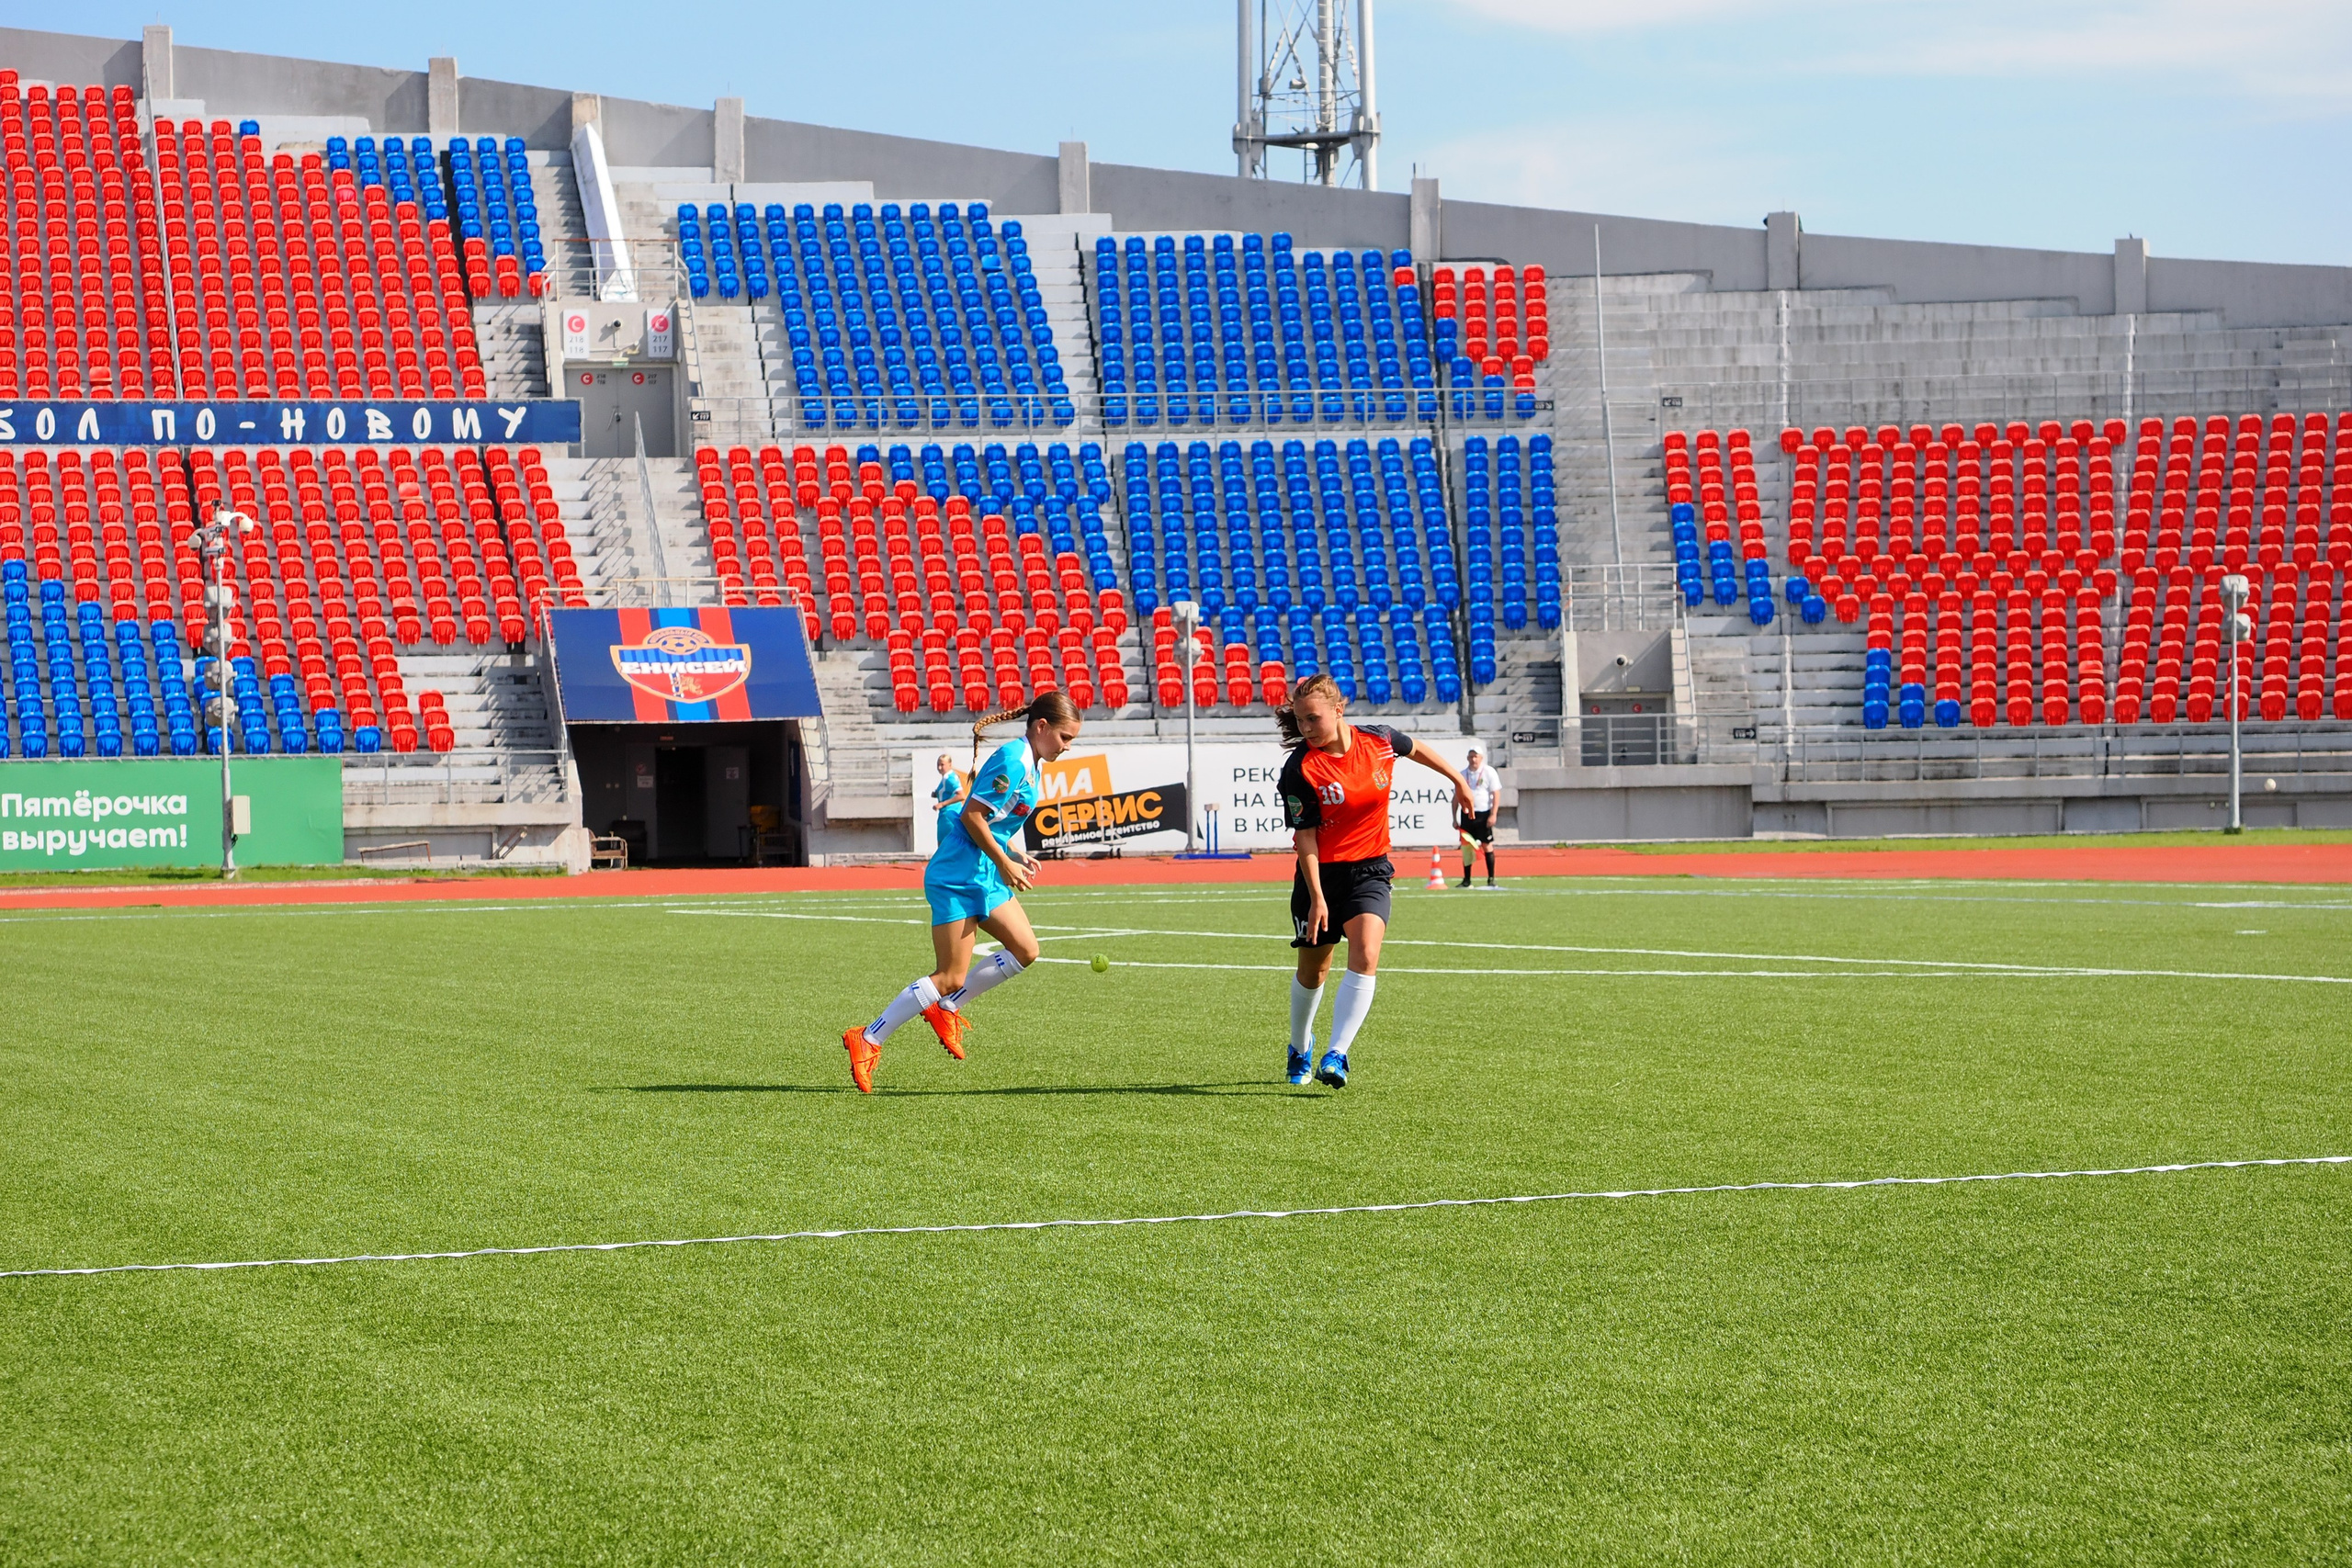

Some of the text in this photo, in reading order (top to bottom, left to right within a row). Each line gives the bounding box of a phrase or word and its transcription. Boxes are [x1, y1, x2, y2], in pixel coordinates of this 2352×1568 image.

[569, 335, 583, 344] 218
[652, 334, 668, 344] 217
[569, 345, 584, 354] 118
[652, 345, 668, 354] 117
[619, 659, 747, 674] ЕНИСЕЙ
[1233, 767, 1283, 783] РЕК
[1234, 792, 1266, 807] НА
[1388, 788, 1455, 805] РАНА
[1318, 781, 1346, 806] 10
[1, 789, 187, 823] Пятёрочка
[1035, 791, 1164, 836] СЕРВИС
[1235, 818, 1248, 833] В
[2, 823, 187, 856] выручает!
